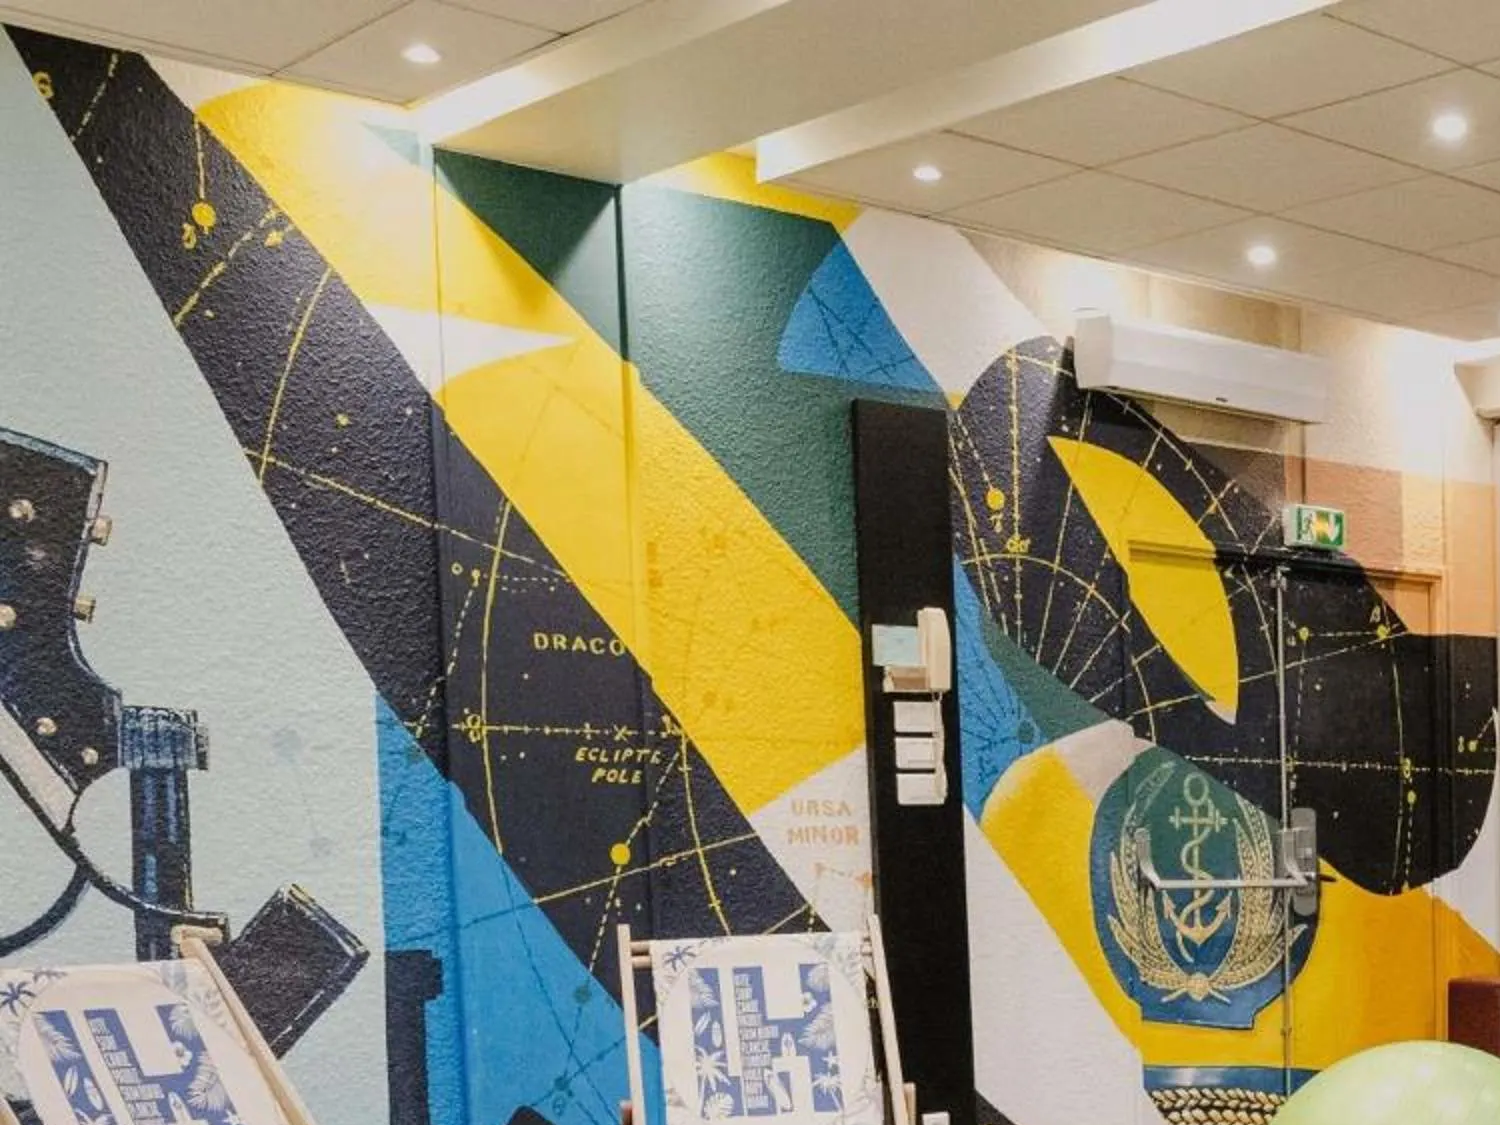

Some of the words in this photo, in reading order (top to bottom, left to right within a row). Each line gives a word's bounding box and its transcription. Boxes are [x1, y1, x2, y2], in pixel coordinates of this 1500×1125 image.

[533, 632, 625, 656] DRACO
[591, 767, 643, 784] POLE
[791, 799, 852, 816] URSA
[787, 826, 860, 845] MINOR
